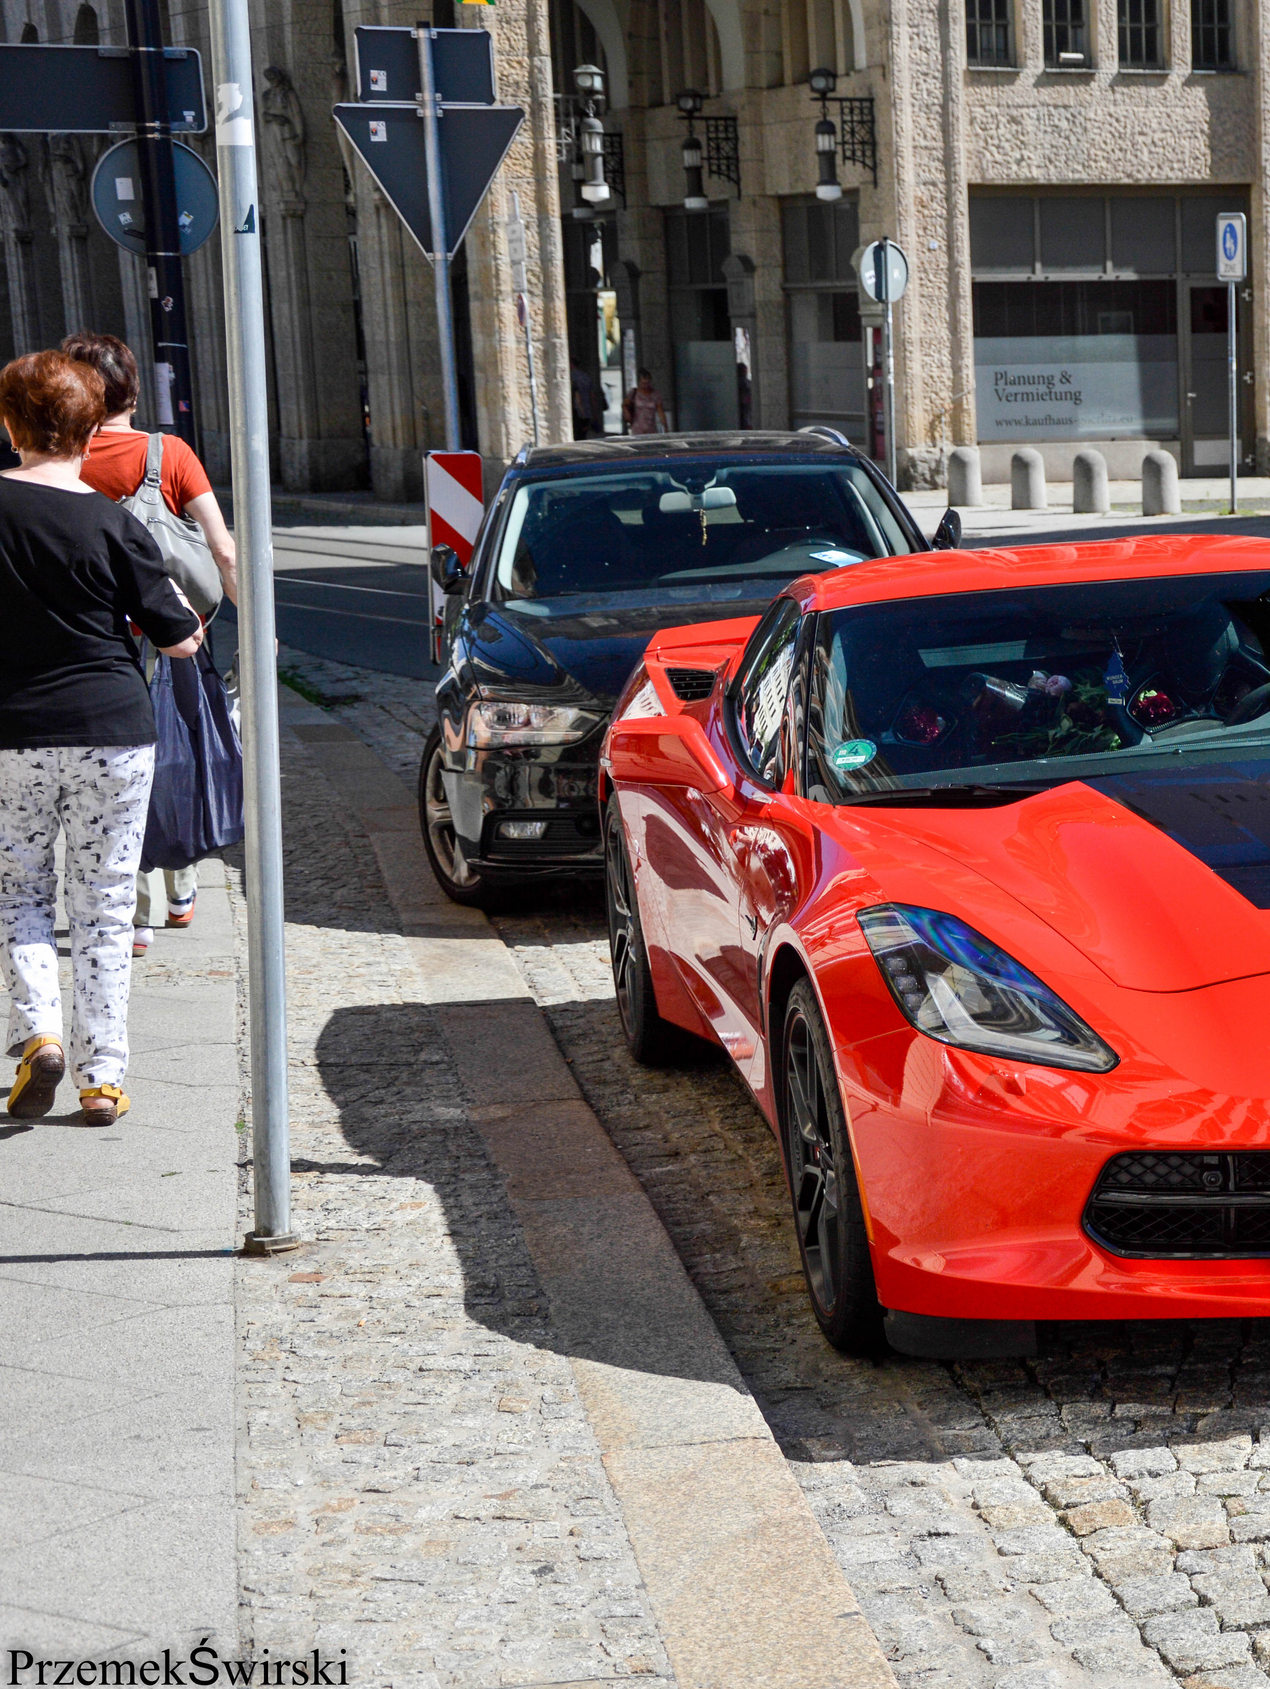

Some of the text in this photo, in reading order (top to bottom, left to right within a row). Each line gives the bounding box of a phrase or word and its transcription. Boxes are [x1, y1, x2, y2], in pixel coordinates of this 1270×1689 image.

[994, 370, 1072, 389] Planung &
[994, 388, 1083, 405] Vermietung
[848, 743, 859, 756] 4
